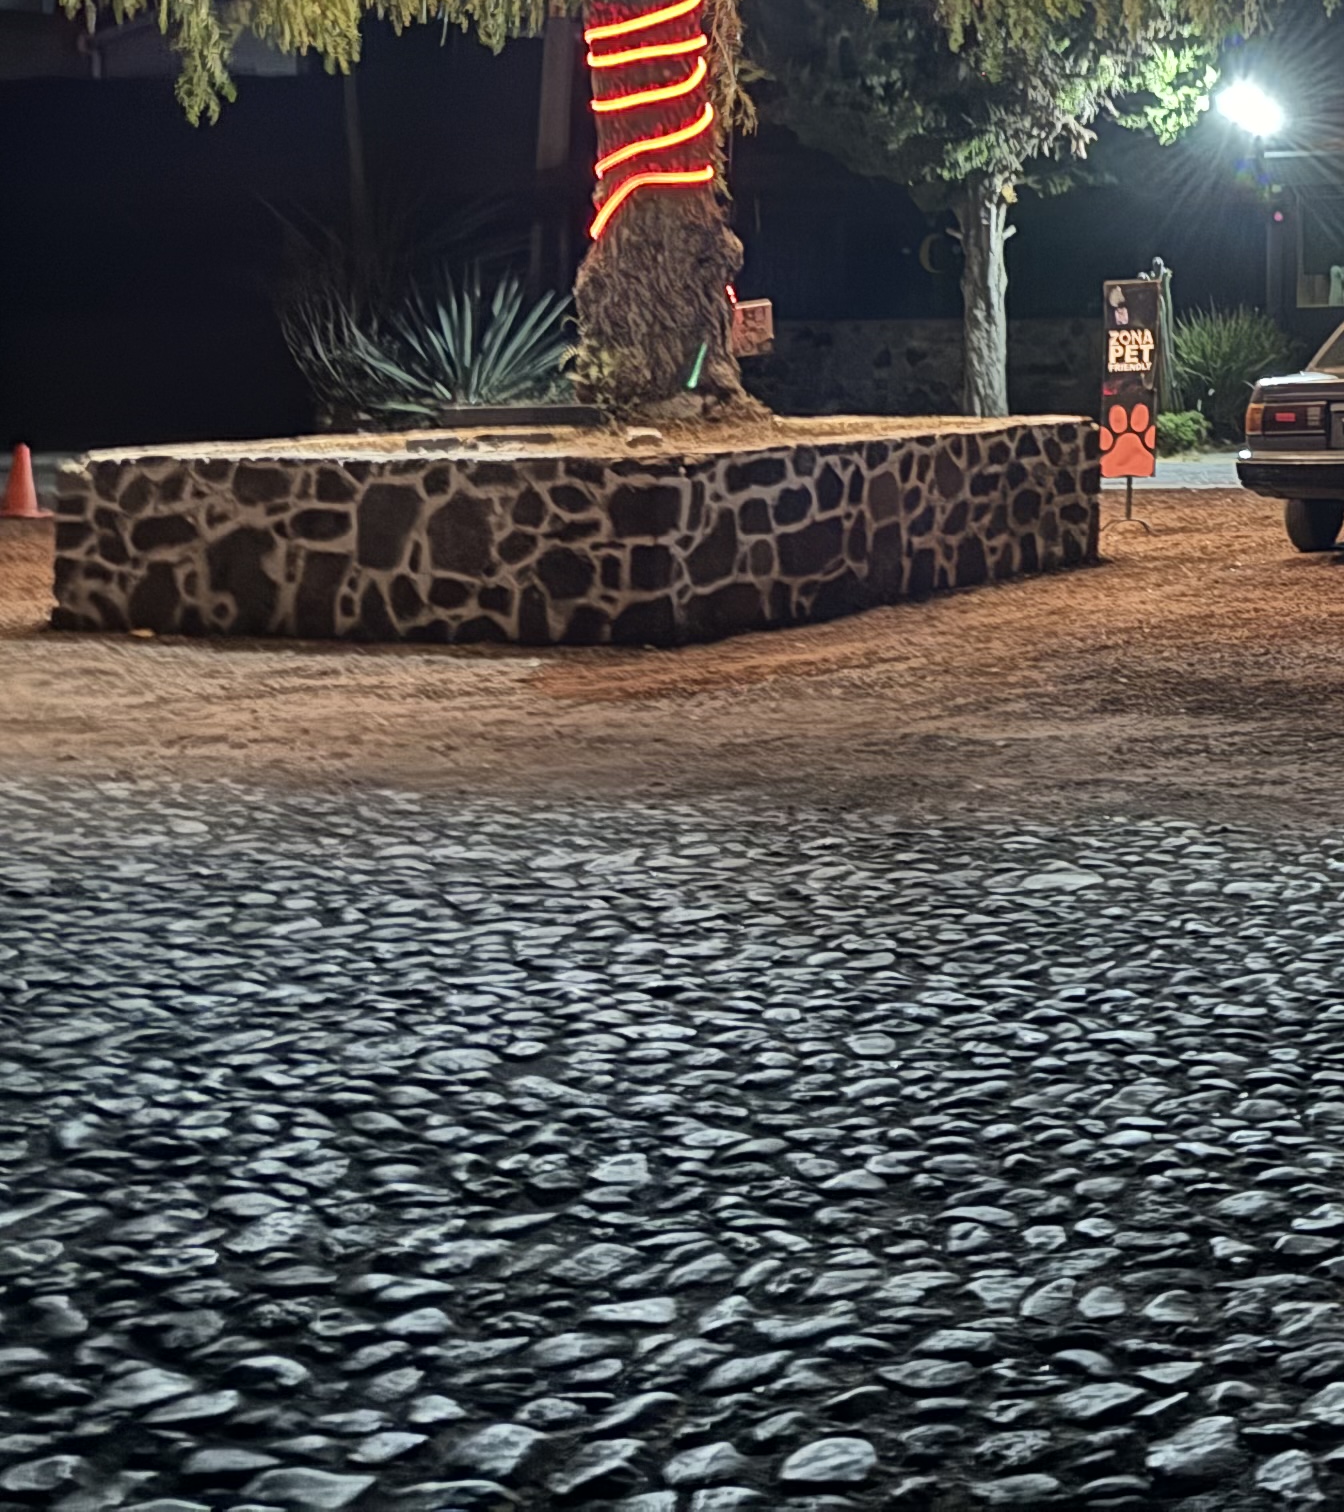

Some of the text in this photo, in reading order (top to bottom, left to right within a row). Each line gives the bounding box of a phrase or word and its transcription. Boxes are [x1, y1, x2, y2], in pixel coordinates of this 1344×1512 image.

[1108, 328, 1154, 346] ZONA
[1108, 344, 1155, 364] PET
[1107, 362, 1153, 373] FRIENDLY
